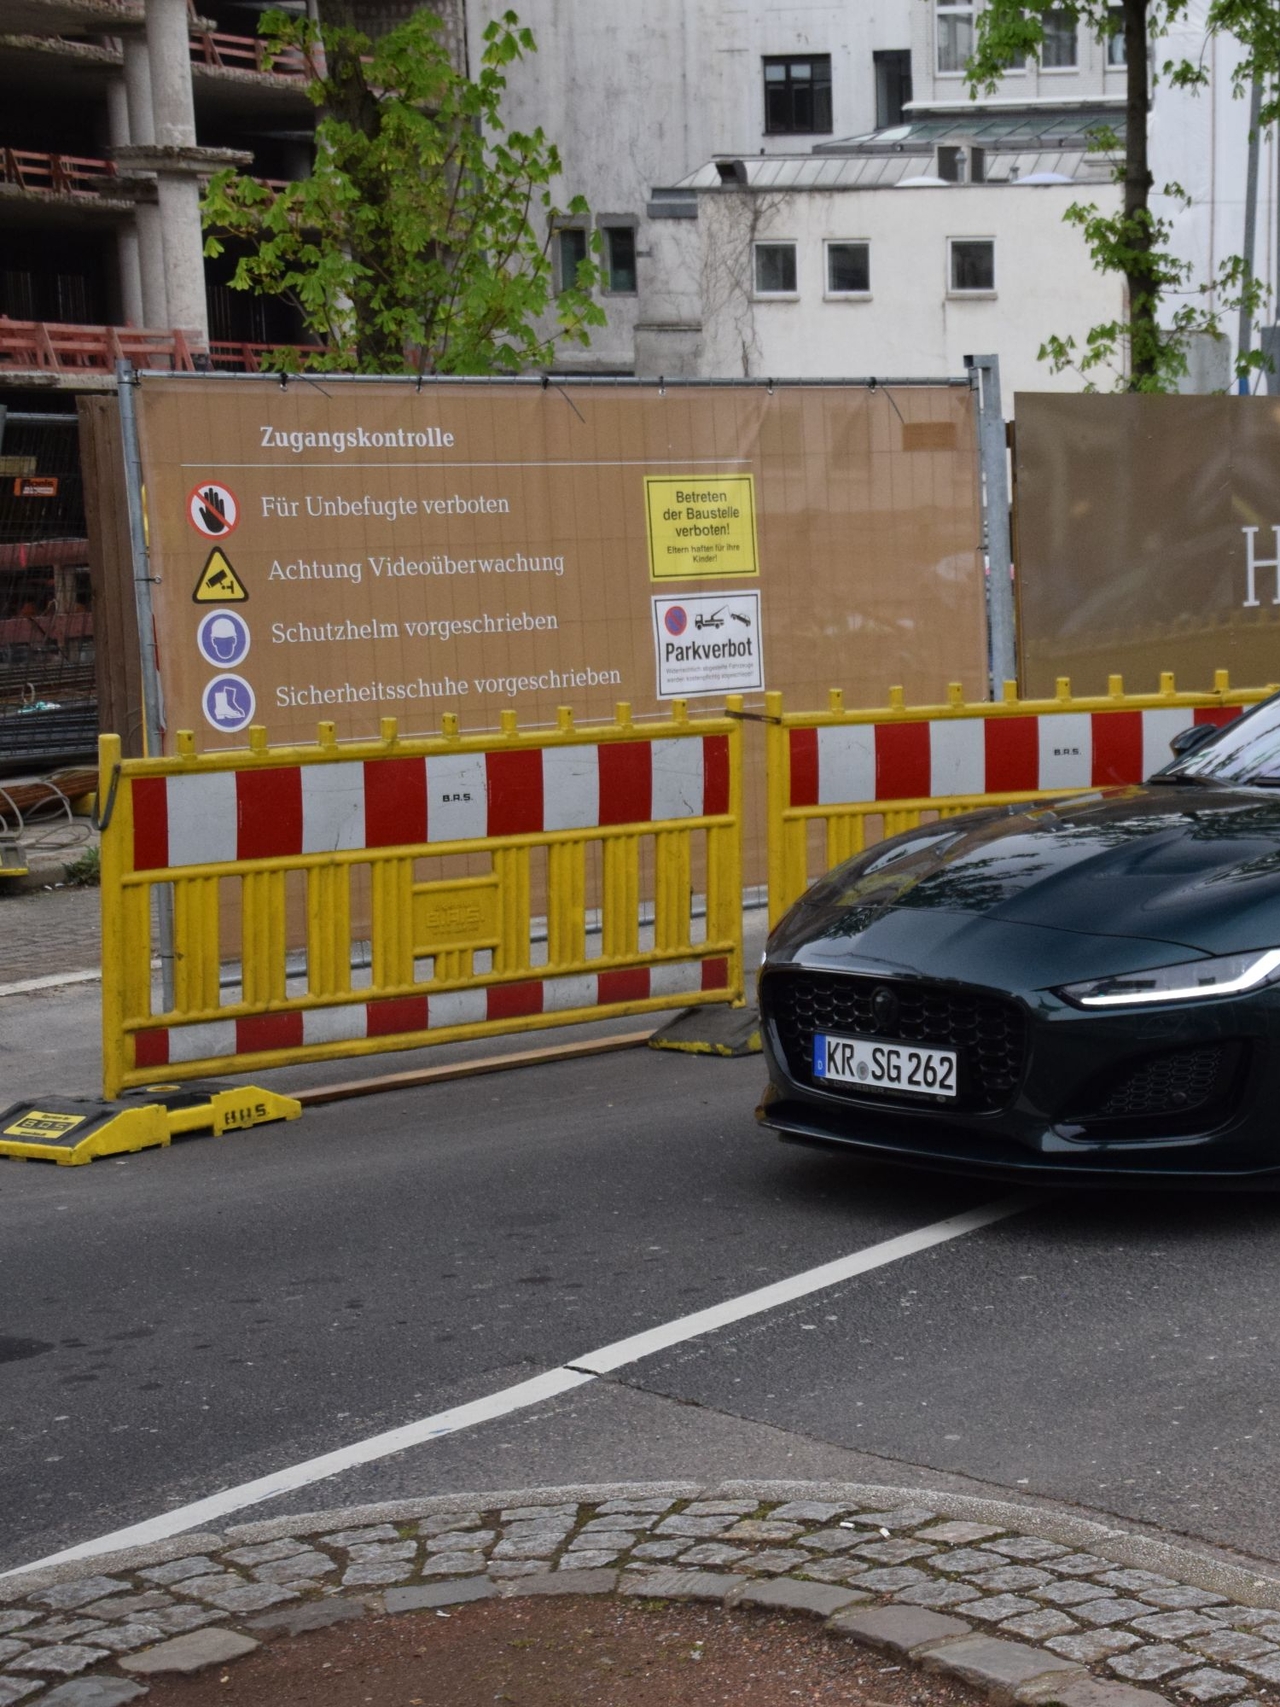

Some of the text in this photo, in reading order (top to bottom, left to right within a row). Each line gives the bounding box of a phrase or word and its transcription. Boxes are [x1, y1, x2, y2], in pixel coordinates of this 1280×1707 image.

[260, 426, 455, 453] Zugangskontrolle
[261, 495, 510, 521] Für Unbefugte verboten
[675, 490, 727, 504] Betreten
[663, 506, 740, 521] der Baustelle
[675, 523, 730, 537] verboten!
[667, 546, 689, 554] Eltern
[691, 545, 713, 553] haften
[268, 553, 564, 584] Achtung Videoüberwachung
[272, 612, 559, 644] Schutzhelm vorgeschrieben
[665, 637, 753, 662] Parkverbot
[276, 667, 621, 707] Sicherheitsschuhe vorgeschrieben
[827, 1041, 954, 1091] KR SG 262
